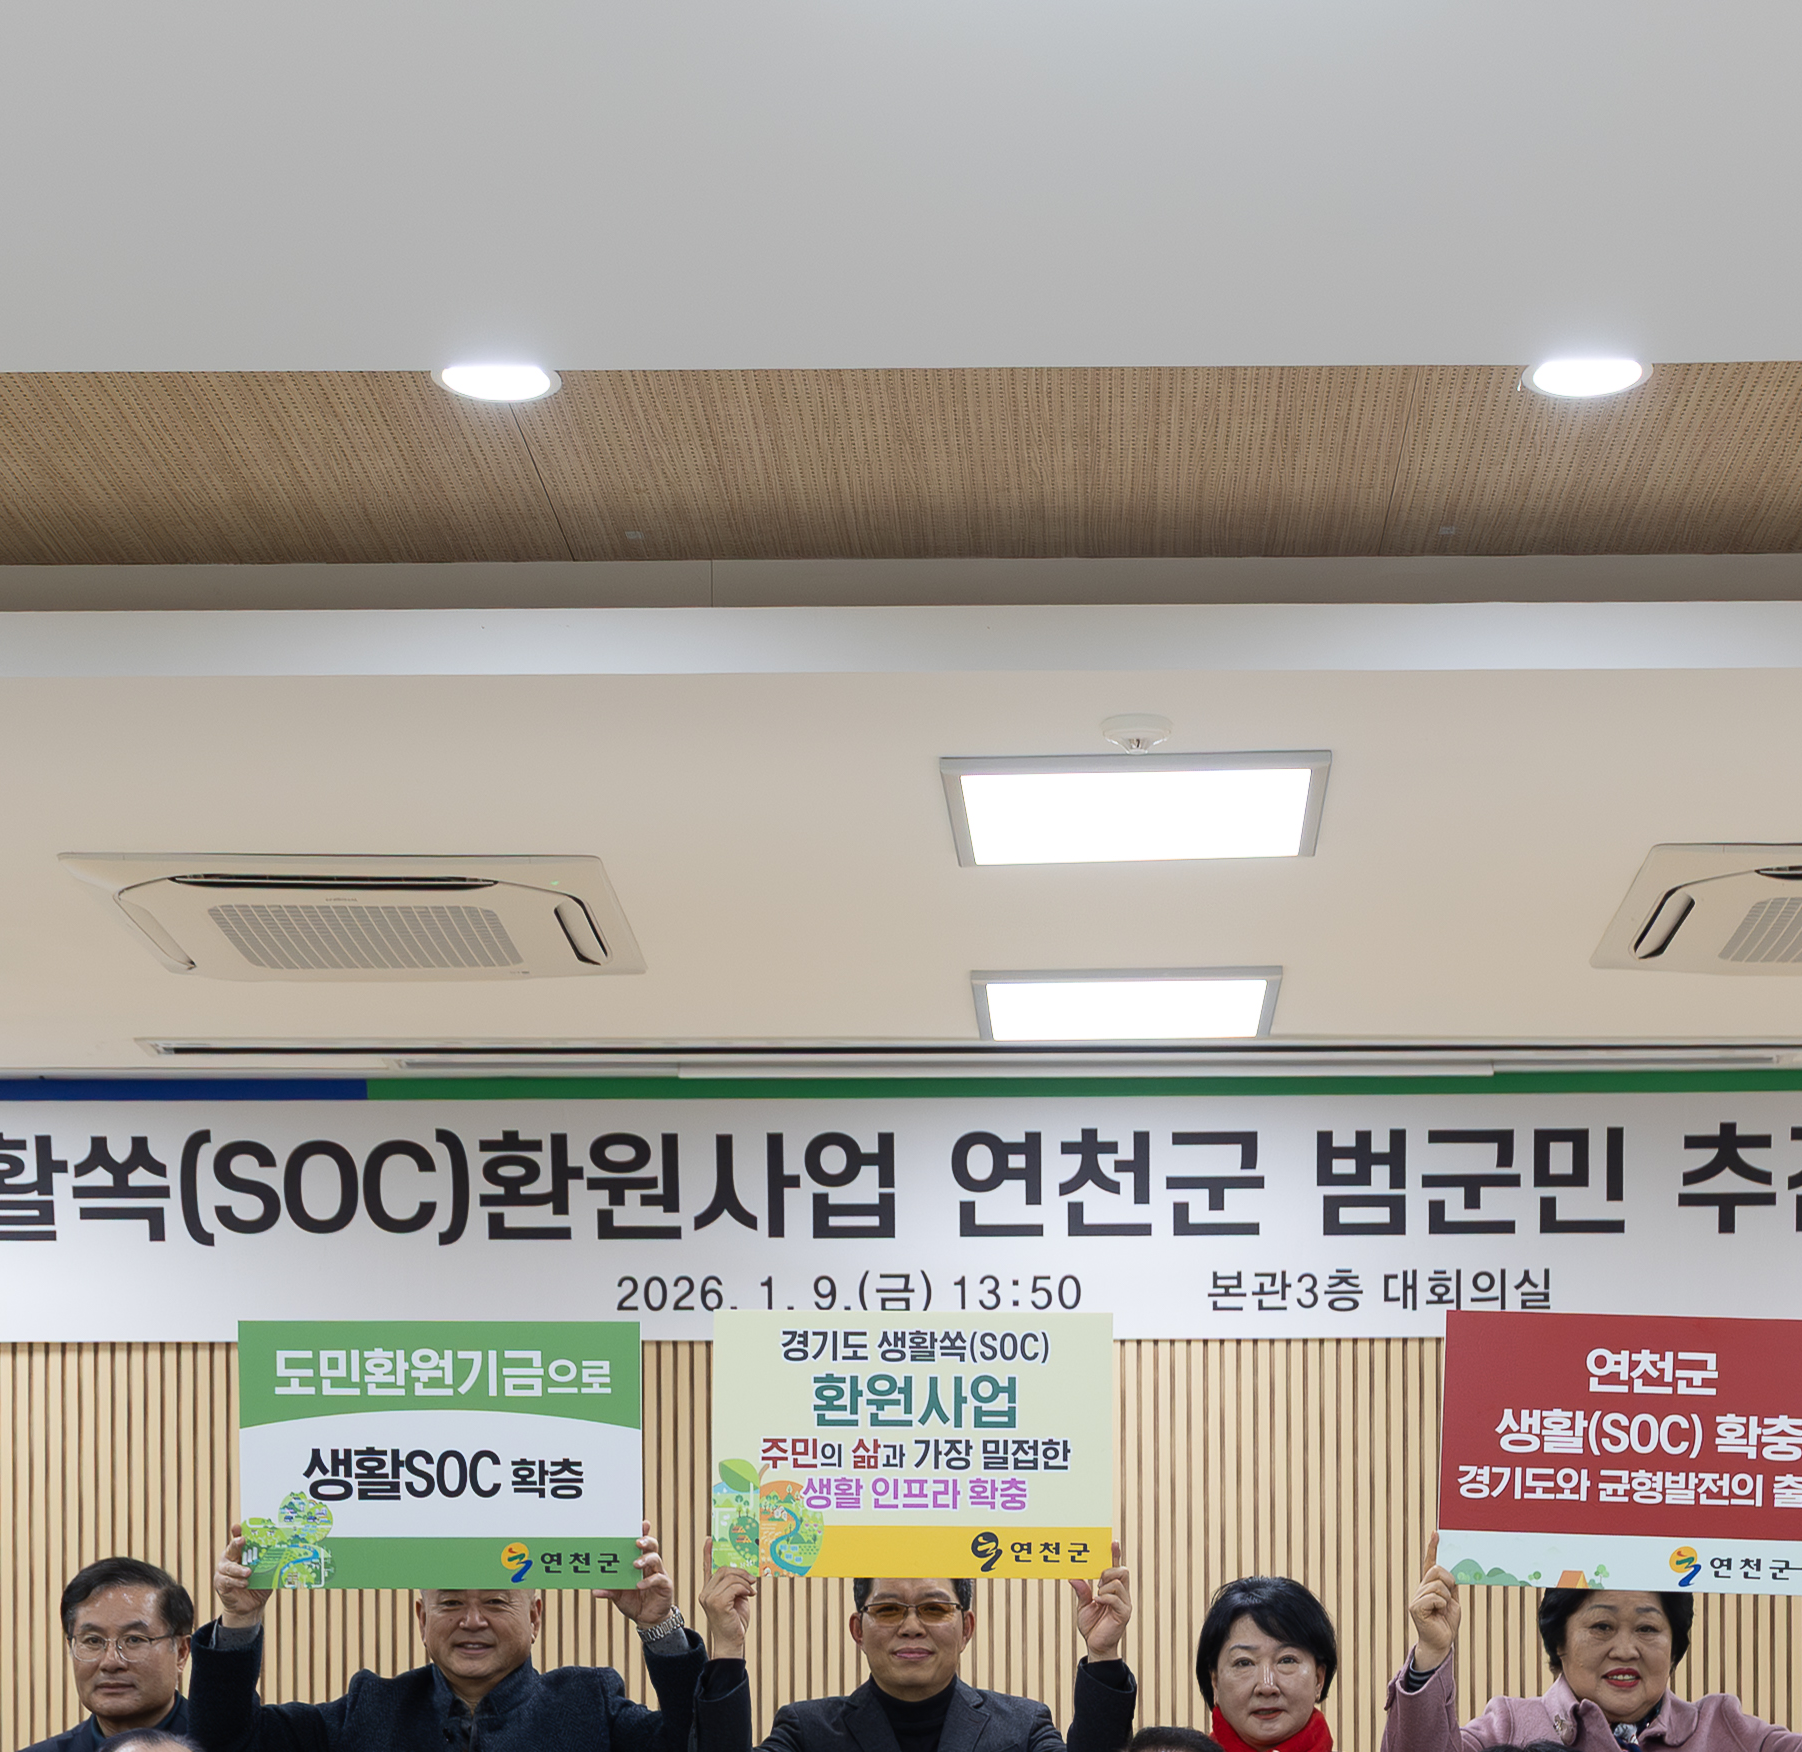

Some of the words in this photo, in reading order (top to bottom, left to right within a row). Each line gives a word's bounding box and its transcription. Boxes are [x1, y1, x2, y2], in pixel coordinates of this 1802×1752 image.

[950, 1128, 1265, 1238] 연천군
[1315, 1125, 1626, 1236] 범군민
[616, 1275, 739, 1311] 2026.
[760, 1275, 795, 1311] 1.
[953, 1274, 1082, 1311] 13:50
[1208, 1268, 1364, 1312] 본관3층
[1383, 1268, 1552, 1312] 대회의실
[780, 1329, 868, 1362] 경기도
[878, 1329, 1050, 1364] 생활쏙(SOC)
[274, 1348, 612, 1397] 도민환원기금으로
[1586, 1347, 1719, 1396] 연천군
[813, 1373, 1018, 1429] 환원사업
[760, 1437, 842, 1470] 주민의
[851, 1438, 905, 1470] 삶과
[914, 1438, 972, 1470] 가장
[981, 1438, 1071, 1471] 밀접한
[1495, 1408, 1704, 1459] 생활(SOC)
[303, 1446, 502, 1502] 생활SOC
[803, 1477, 864, 1510] 생활
[871, 1477, 960, 1510] 인프라
[968, 1477, 1028, 1511] 확충
[1457, 1465, 1590, 1502] 경기도와
[1598, 1469, 1764, 1508] 균형발전의
[540, 1552, 620, 1574] 연천군
[1011, 1541, 1091, 1563] 연천군
[1710, 1556, 1790, 1581] 연천군
